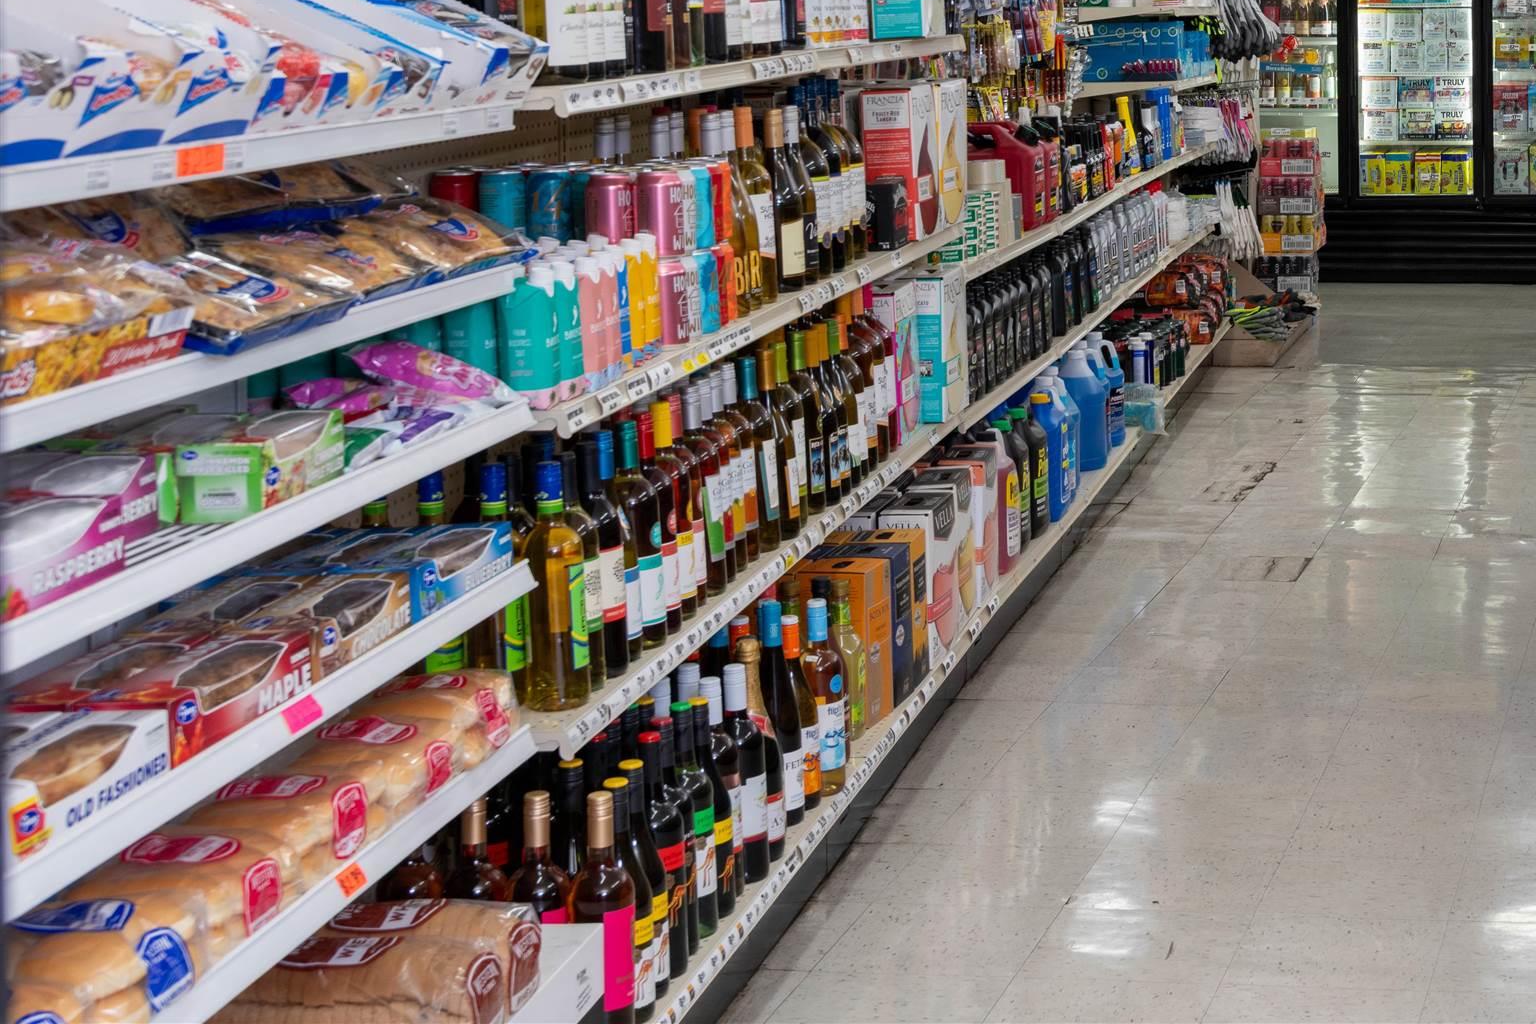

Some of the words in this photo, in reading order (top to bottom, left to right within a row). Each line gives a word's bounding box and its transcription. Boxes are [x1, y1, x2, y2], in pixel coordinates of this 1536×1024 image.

[1405, 79, 1429, 87] TRULY
[1439, 78, 1462, 86] TRULY
[866, 95, 904, 106] FRANZIA
[1438, 110, 1461, 119] TRULY
[120, 493, 158, 527] BERRY
[933, 507, 954, 530] VELLA
[31, 538, 126, 596] RASPBERRY
[351, 604, 411, 660] CHOCOLATE
[258, 662, 313, 714] MAPLE
[66, 803, 94, 828] OLD
[96, 753, 168, 814] FASHIONED
